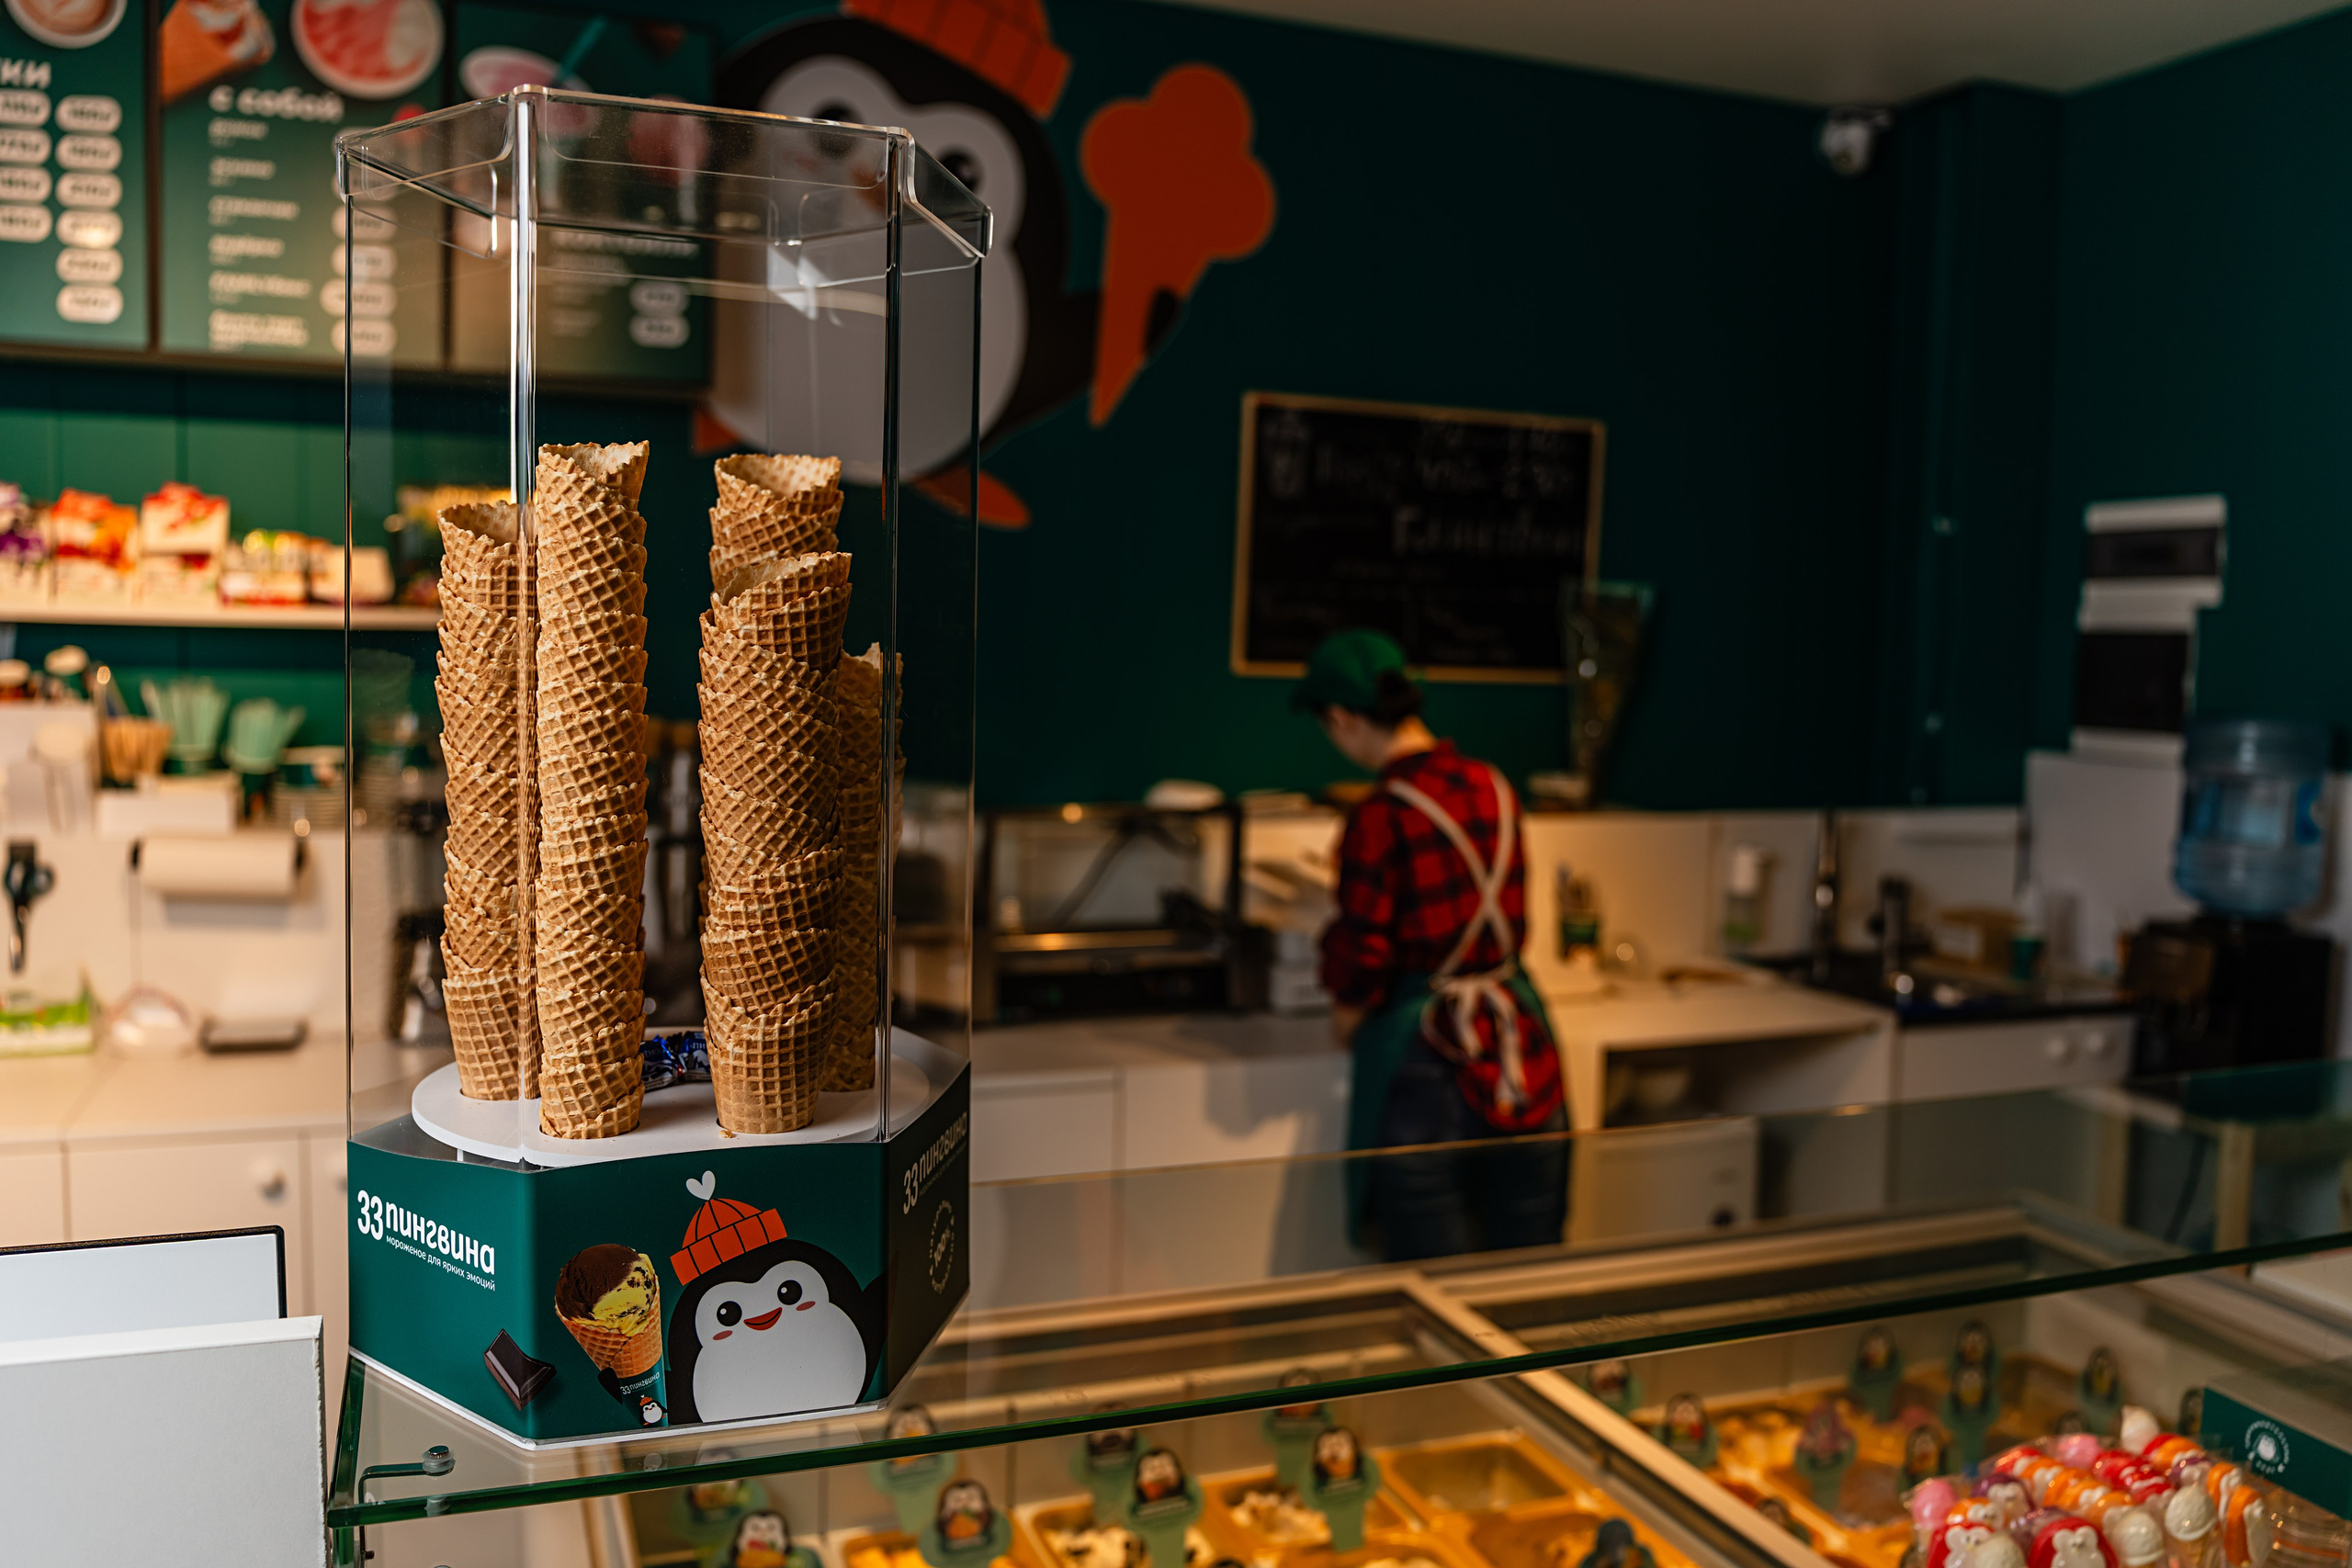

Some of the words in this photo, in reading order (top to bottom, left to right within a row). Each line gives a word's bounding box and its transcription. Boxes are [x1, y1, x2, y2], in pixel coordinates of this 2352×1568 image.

[903, 1163, 918, 1214] 33
[919, 1111, 967, 1183] пингвина
[357, 1190, 384, 1240] 33
[385, 1201, 495, 1275] пингвина
[386, 1235, 426, 1260] мороженое
[427, 1254, 441, 1267] для
[443, 1260, 465, 1278] ярких
[466, 1271, 495, 1292] эмоций
[619, 1385, 631, 1395] 33
[629, 1371, 661, 1391] пингвина
